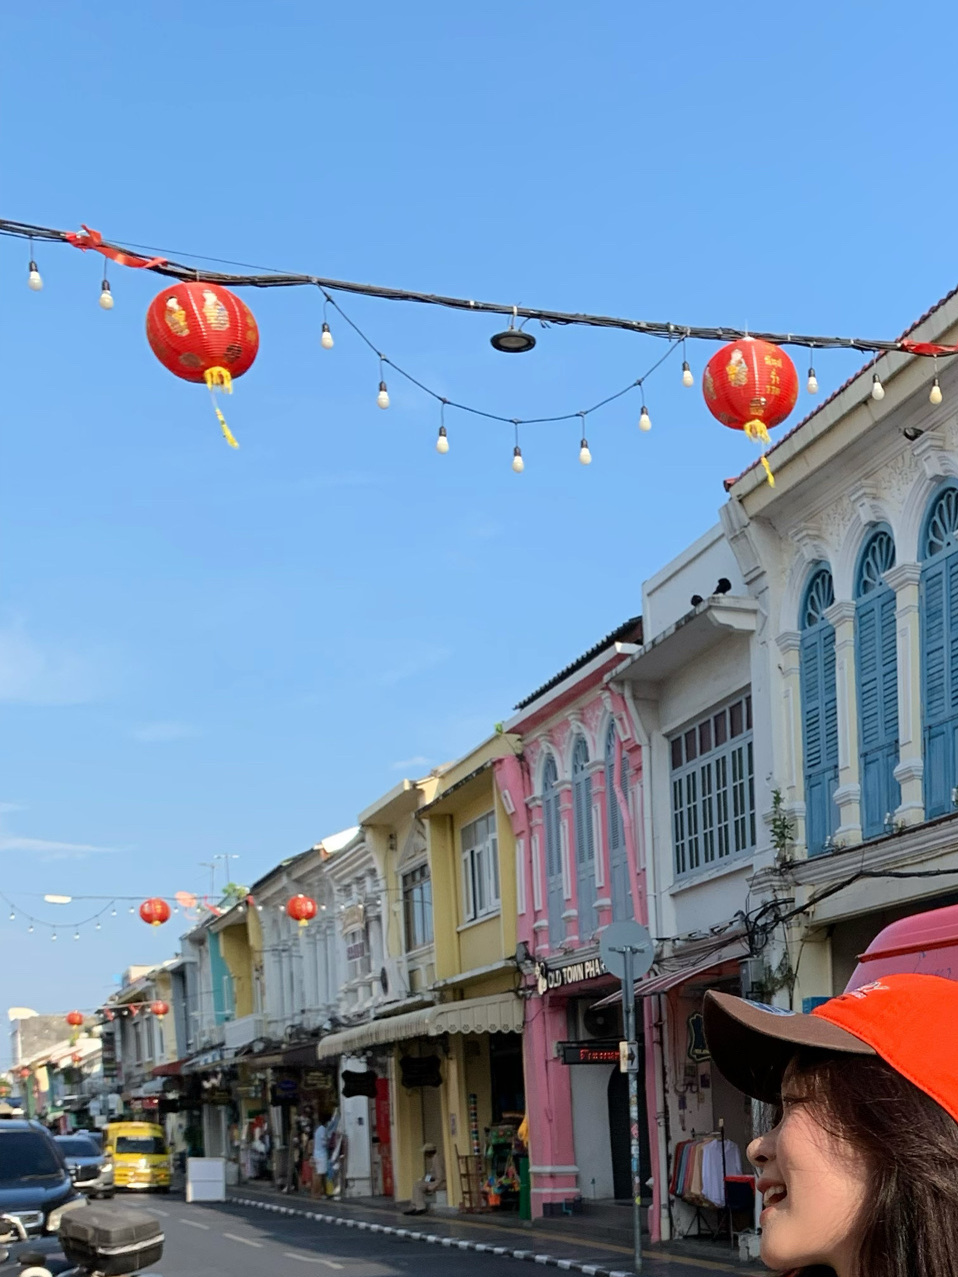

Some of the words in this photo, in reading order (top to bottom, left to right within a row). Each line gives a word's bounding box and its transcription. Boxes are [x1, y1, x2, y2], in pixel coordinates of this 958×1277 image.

[548, 970, 562, 989] OLD
[562, 963, 584, 985] TOWN
[585, 958, 607, 979] PHA
